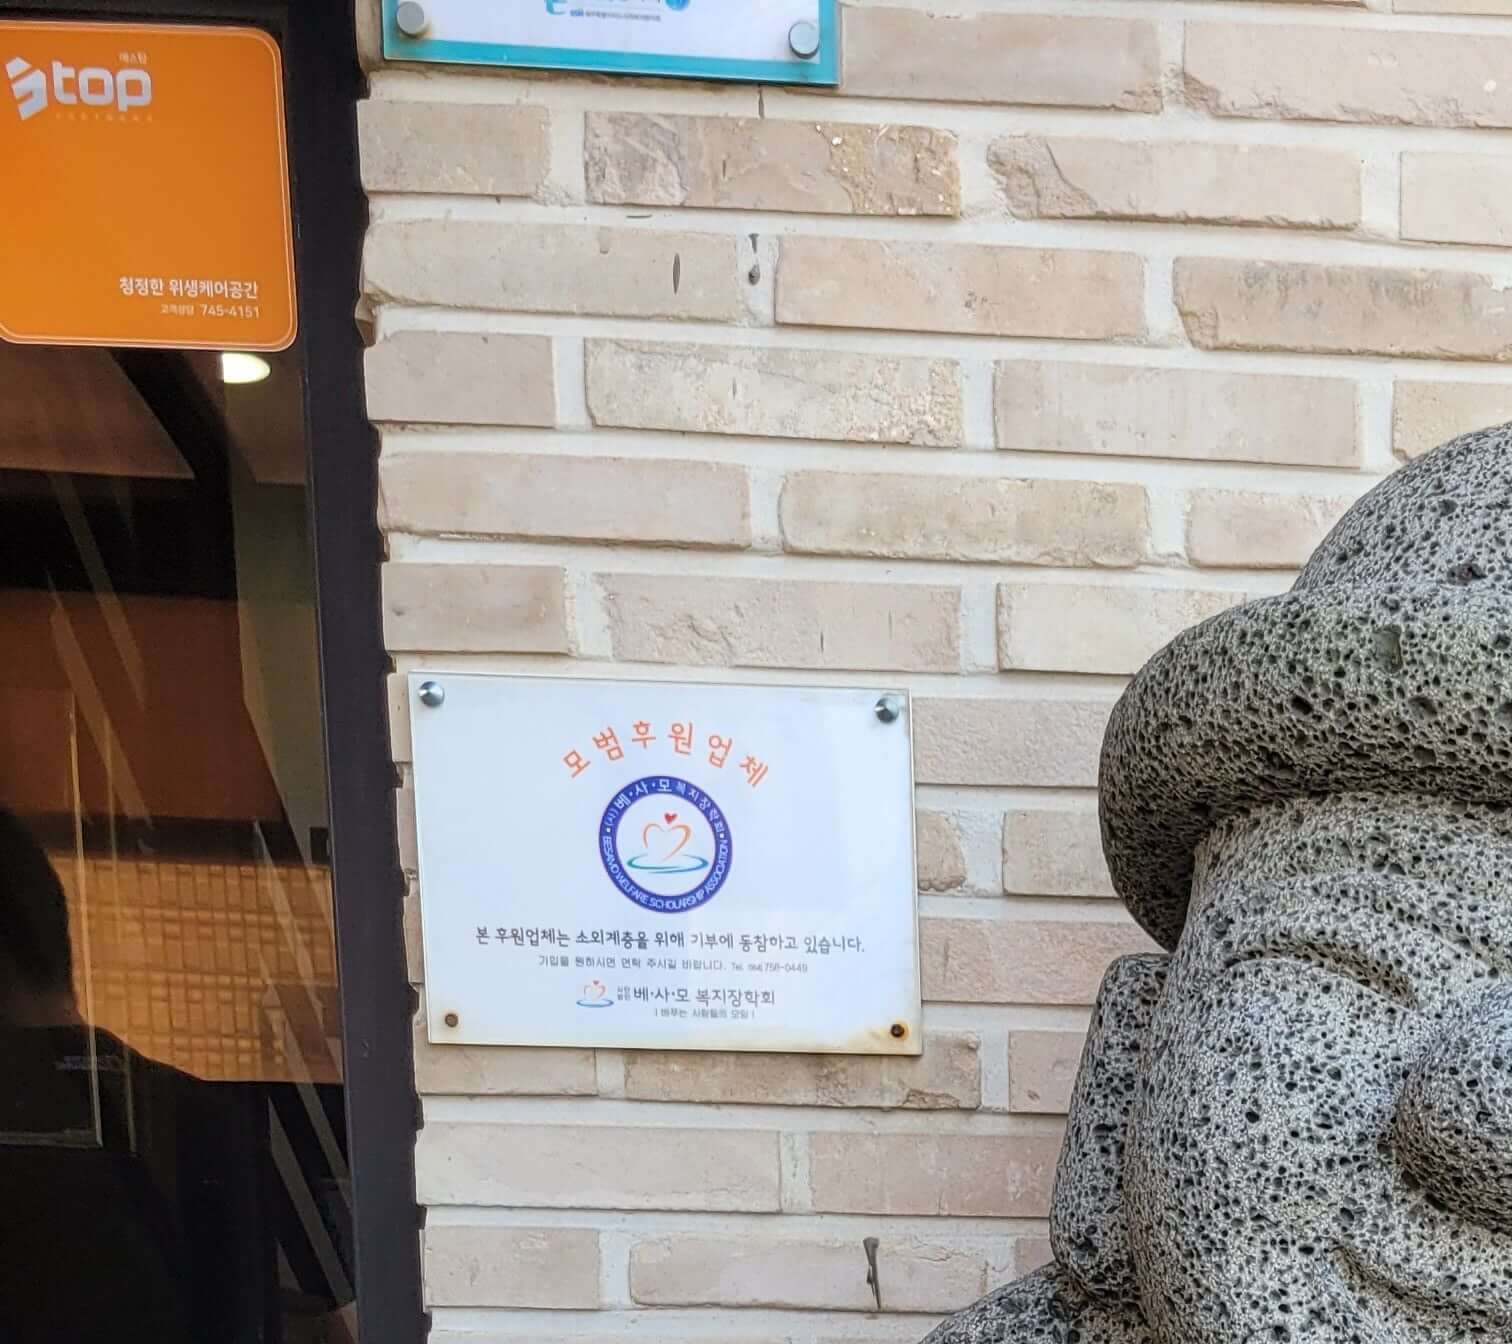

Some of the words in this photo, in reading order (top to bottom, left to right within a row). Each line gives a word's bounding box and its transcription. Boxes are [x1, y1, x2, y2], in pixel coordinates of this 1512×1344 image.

[119, 275, 164, 296] 청정한
[168, 279, 259, 300] 위생케어공간
[200, 303, 260, 319] 745-4151
[563, 720, 769, 788] 모범후원업체
[475, 926, 490, 945] 본
[495, 927, 571, 947] 후원업체는
[575, 929, 649, 951] 소외계층을
[653, 931, 685, 948] 위해
[690, 932, 734, 950] 기부에
[738, 934, 799, 953] 동참하고
[803, 936, 866, 955] 있습니다.
[695, 987, 776, 1008] 복지장학회
